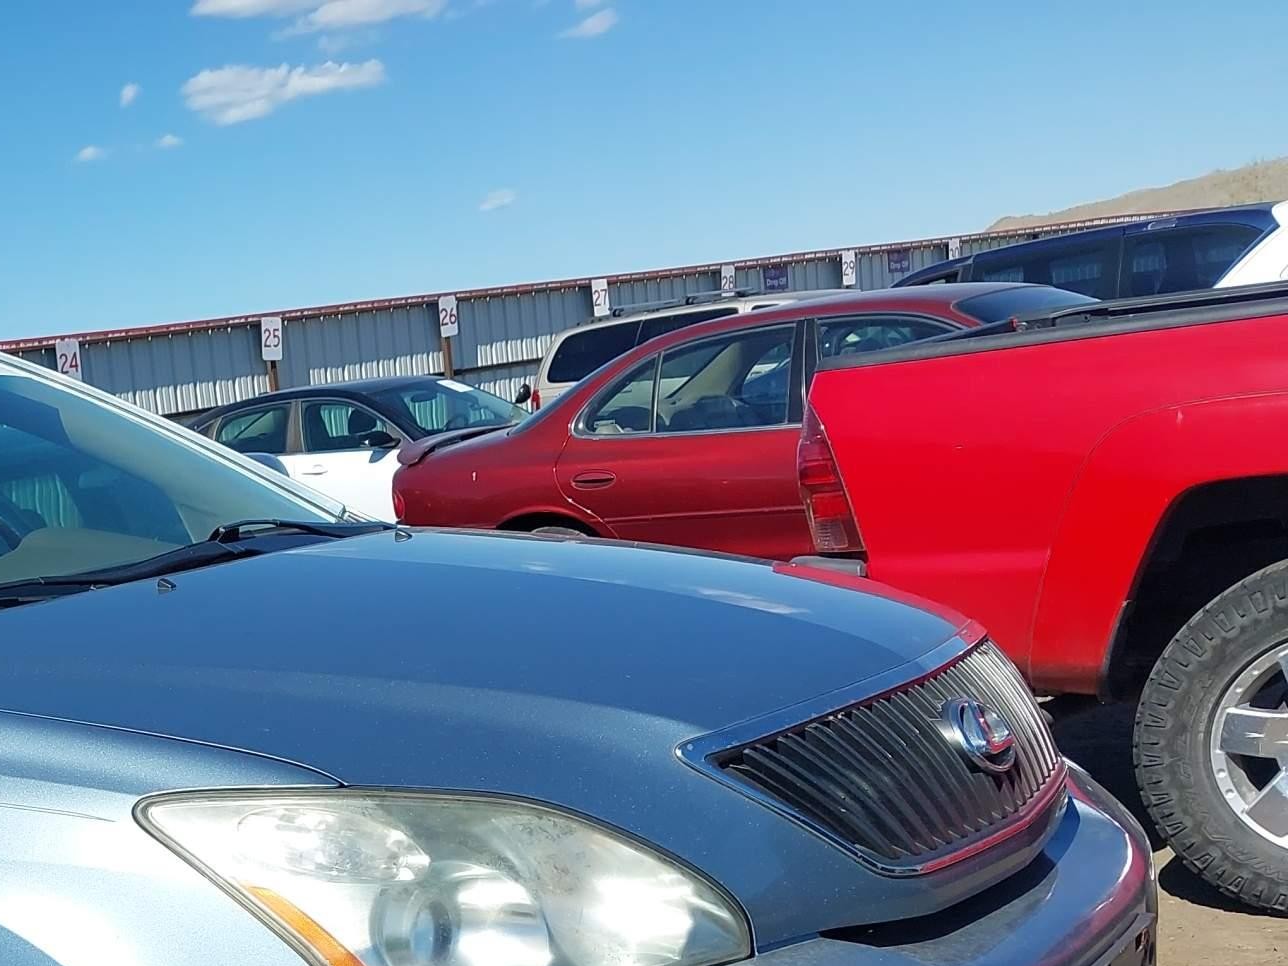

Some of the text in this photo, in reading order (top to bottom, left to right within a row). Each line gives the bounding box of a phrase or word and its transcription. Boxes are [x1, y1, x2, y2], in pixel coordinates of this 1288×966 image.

[843, 259, 855, 277] 29
[722, 274, 734, 290] 28
[594, 289, 608, 306] 27
[440, 307, 457, 327] 26
[263, 328, 281, 348] 25
[58, 351, 79, 374] 24
